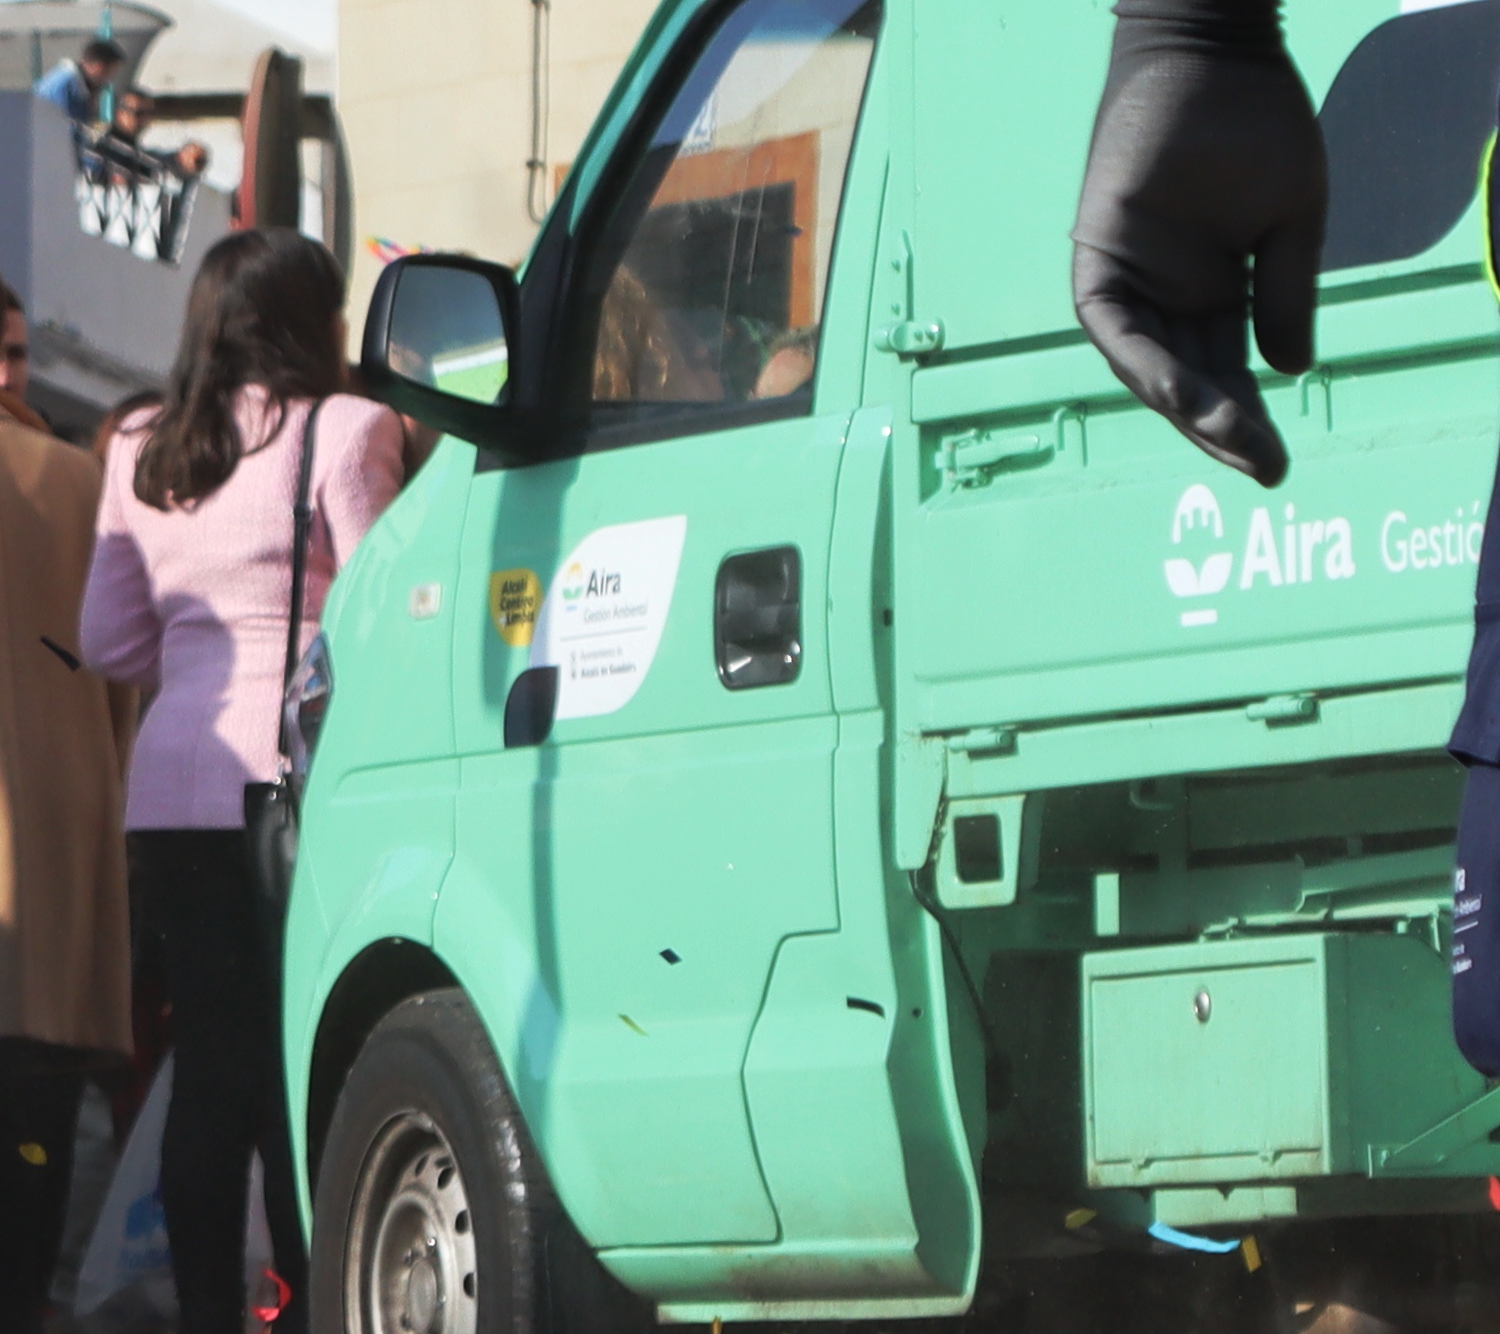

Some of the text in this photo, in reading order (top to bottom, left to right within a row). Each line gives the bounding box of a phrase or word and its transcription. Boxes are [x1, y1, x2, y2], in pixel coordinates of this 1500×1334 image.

[1240, 500, 1485, 590] Aira Gestió
[586, 568, 621, 598] Aira
